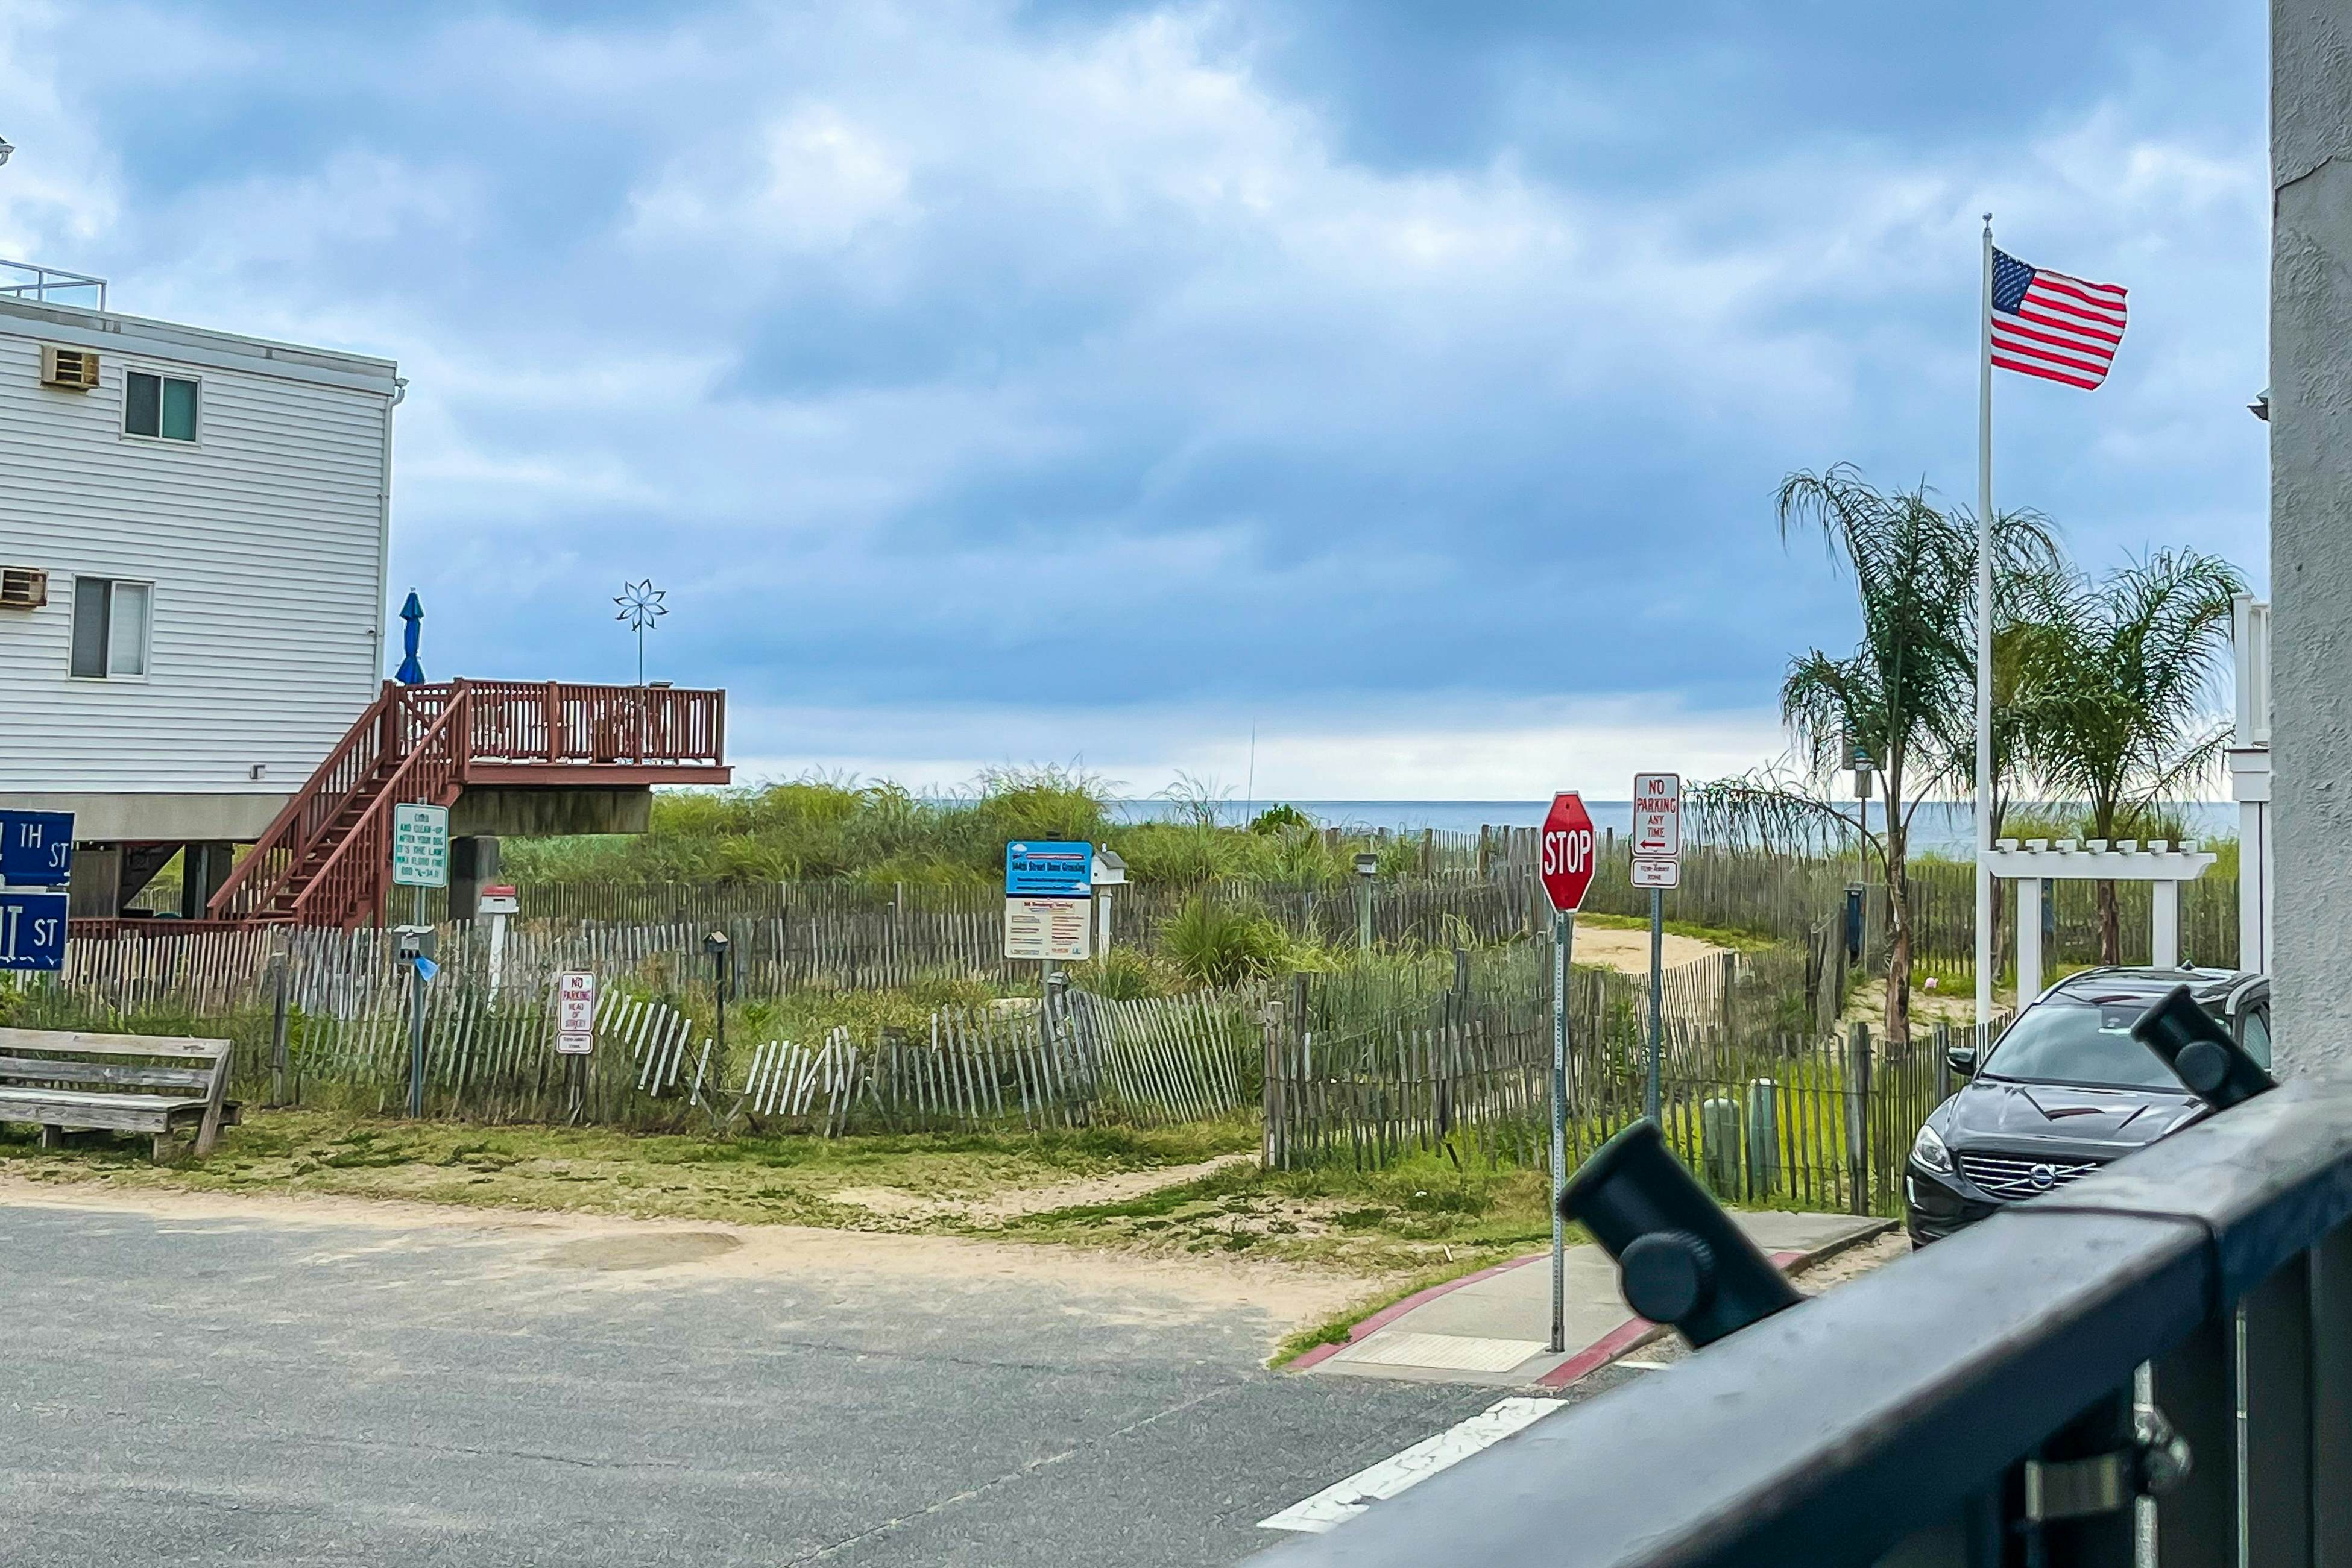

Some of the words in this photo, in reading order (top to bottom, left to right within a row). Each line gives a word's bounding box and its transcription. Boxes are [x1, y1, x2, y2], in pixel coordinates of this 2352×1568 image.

[1648, 779, 1665, 795] NO
[1636, 798, 1676, 814] PARKING
[1647, 815, 1665, 825] ANY
[1647, 827, 1665, 837] TIME
[49, 843, 69, 868] ST
[1544, 830, 1591, 875] STOP
[34, 918, 58, 947] ST
[571, 977, 583, 989] NO
[562, 990, 591, 1001] PARKING
